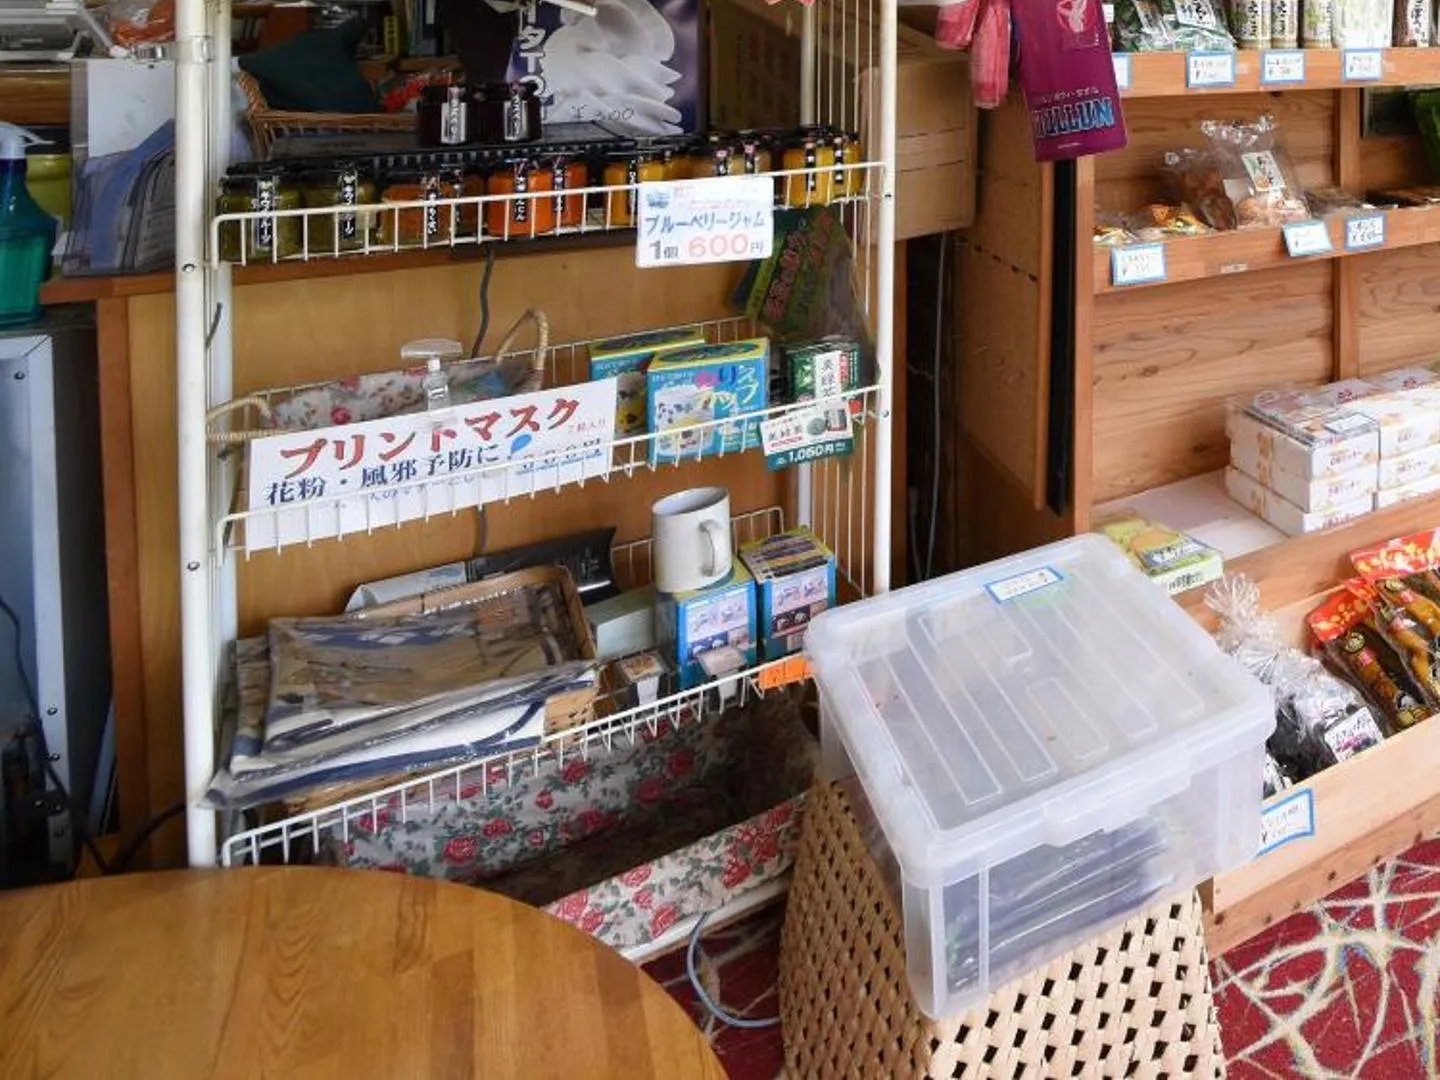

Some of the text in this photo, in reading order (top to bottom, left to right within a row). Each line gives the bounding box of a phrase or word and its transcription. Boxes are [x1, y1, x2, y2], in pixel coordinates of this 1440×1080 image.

[644, 211, 766, 236] ブルーベリージャム
[649, 233, 764, 260] 1個 600円
[279, 397, 581, 479] プリントマスク
[265, 443, 499, 507] 花粉・風邪予防に
